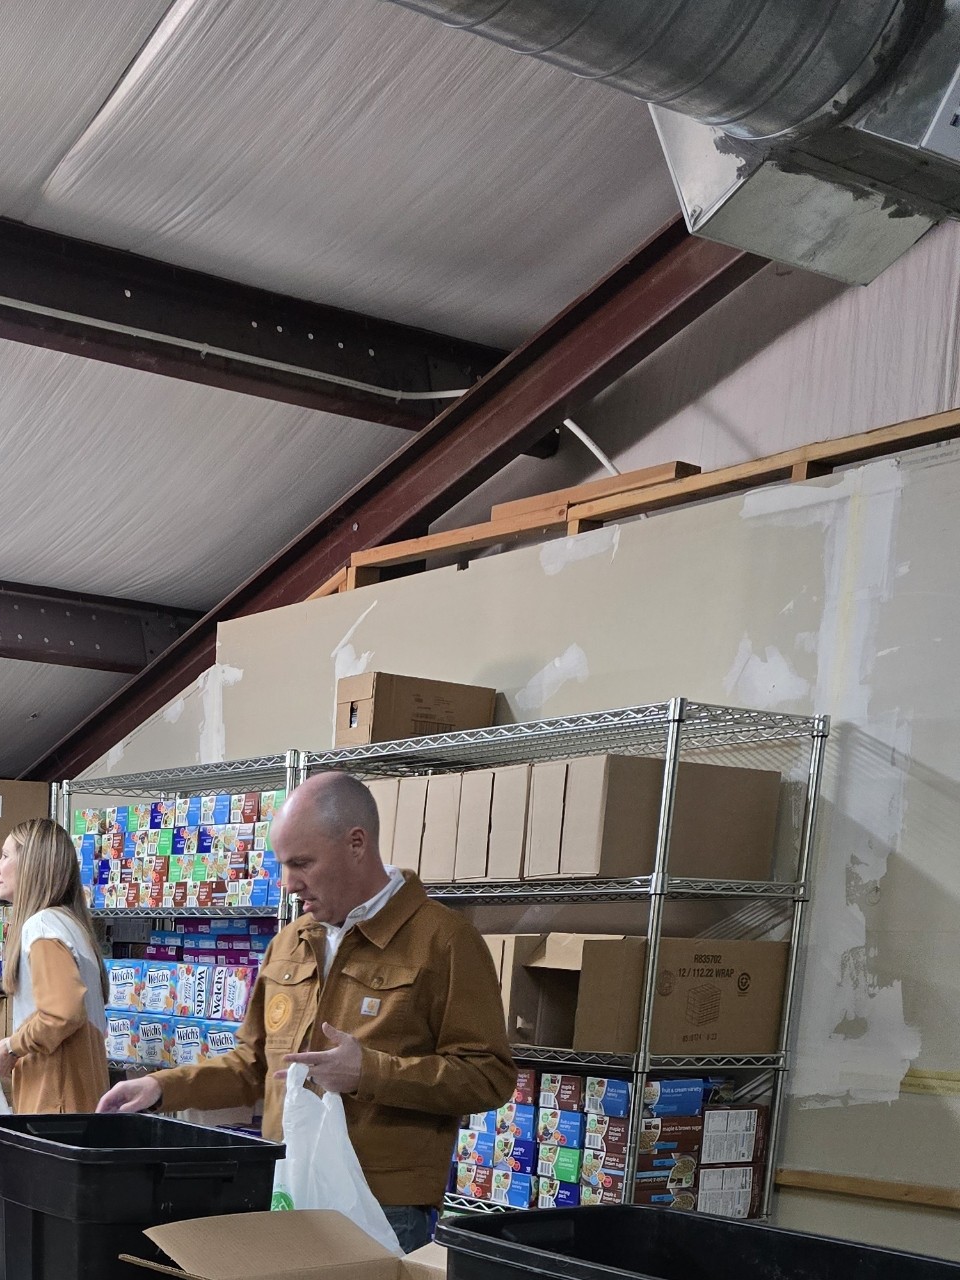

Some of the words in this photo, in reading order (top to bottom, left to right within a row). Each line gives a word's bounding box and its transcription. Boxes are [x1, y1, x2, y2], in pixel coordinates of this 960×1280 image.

[111, 970, 134, 982] Welch's
[148, 971, 169, 985] Welch's
[679, 967, 686, 978] 12
[693, 967, 714, 978] 112.22
[715, 968, 735, 978] WRAP
[196, 970, 206, 1015] Welch's
[213, 969, 224, 1015] Welch's
[110, 1020, 130, 1033] Welch's
[141, 1025, 162, 1038] Welch's
[177, 1028, 199, 1042] Welch's
[209, 1033, 234, 1047] Welch's
